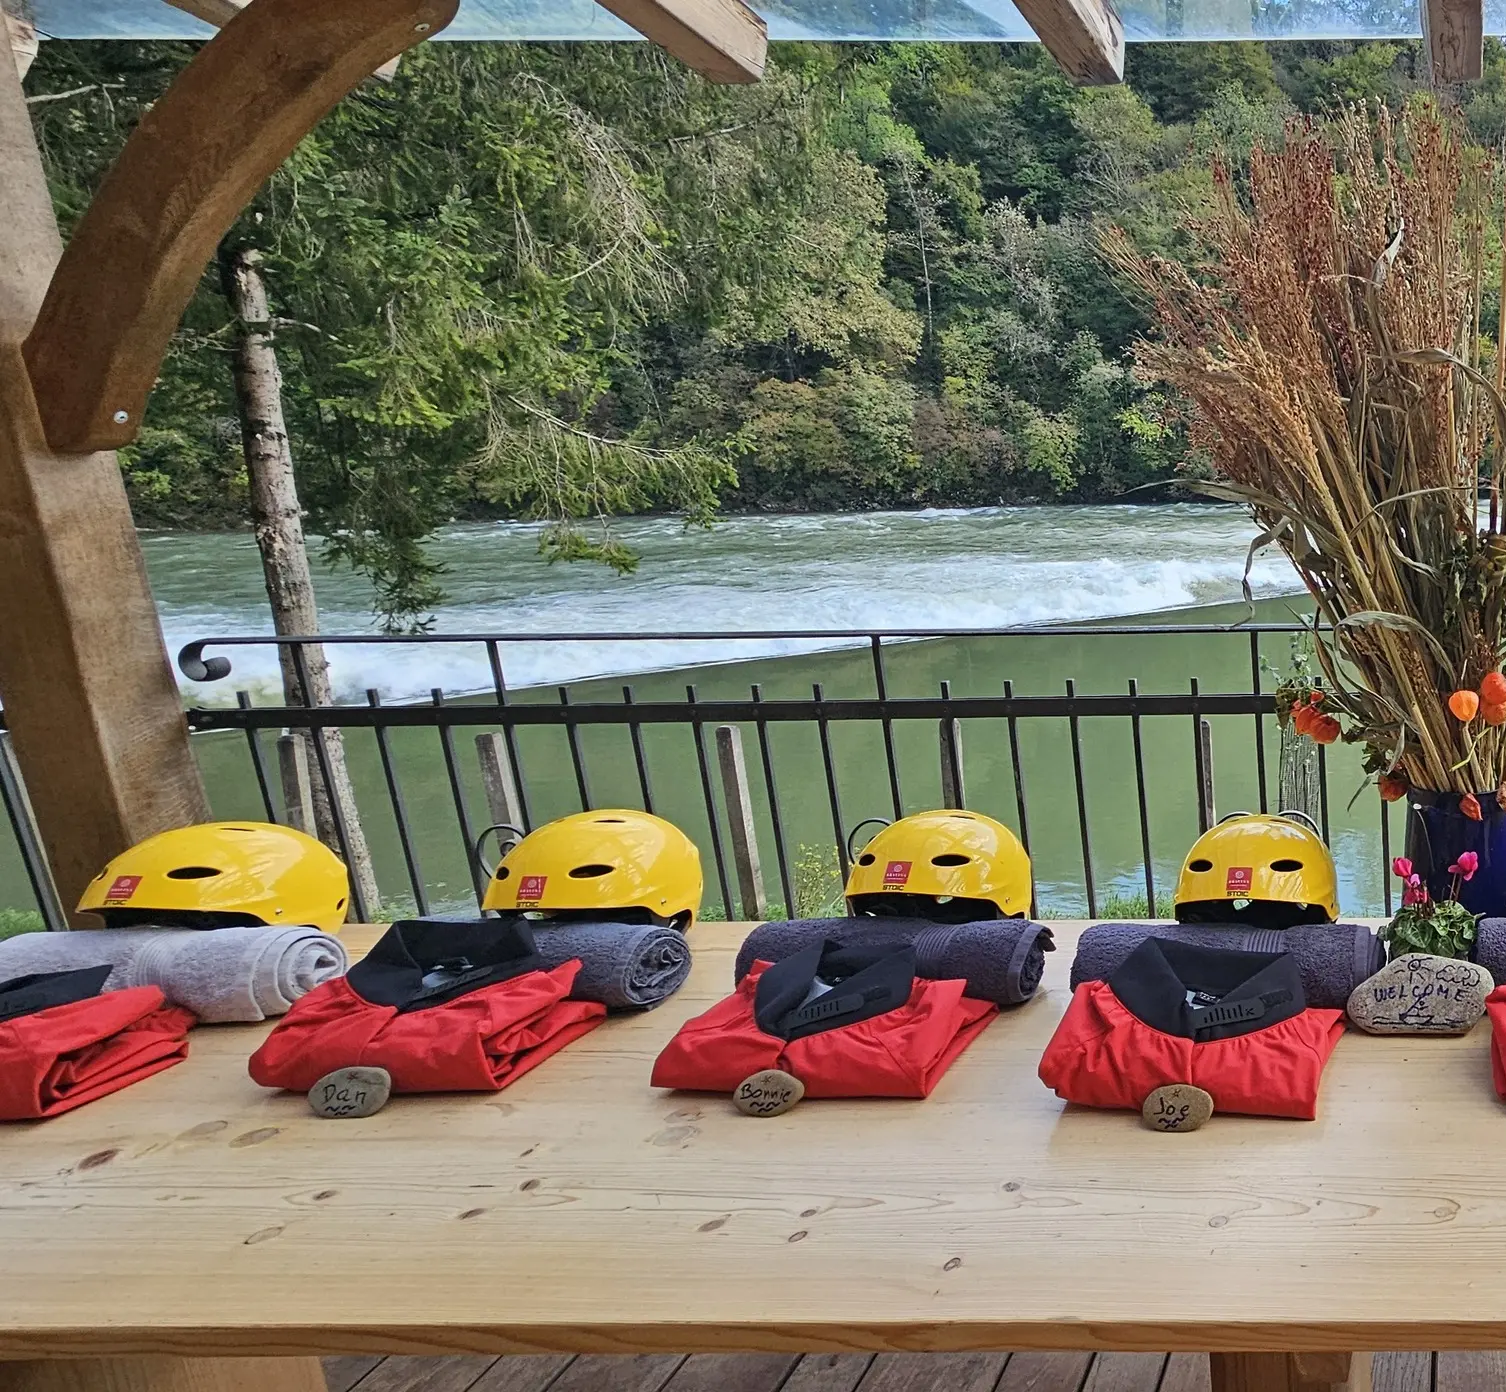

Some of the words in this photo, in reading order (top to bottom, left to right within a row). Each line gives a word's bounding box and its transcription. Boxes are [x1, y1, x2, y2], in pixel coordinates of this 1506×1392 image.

[1373, 984, 1469, 1002] WELCOME
[322, 1084, 367, 1104] Dan
[740, 1083, 792, 1102] Bonnie
[1153, 1097, 1190, 1117] Joe
